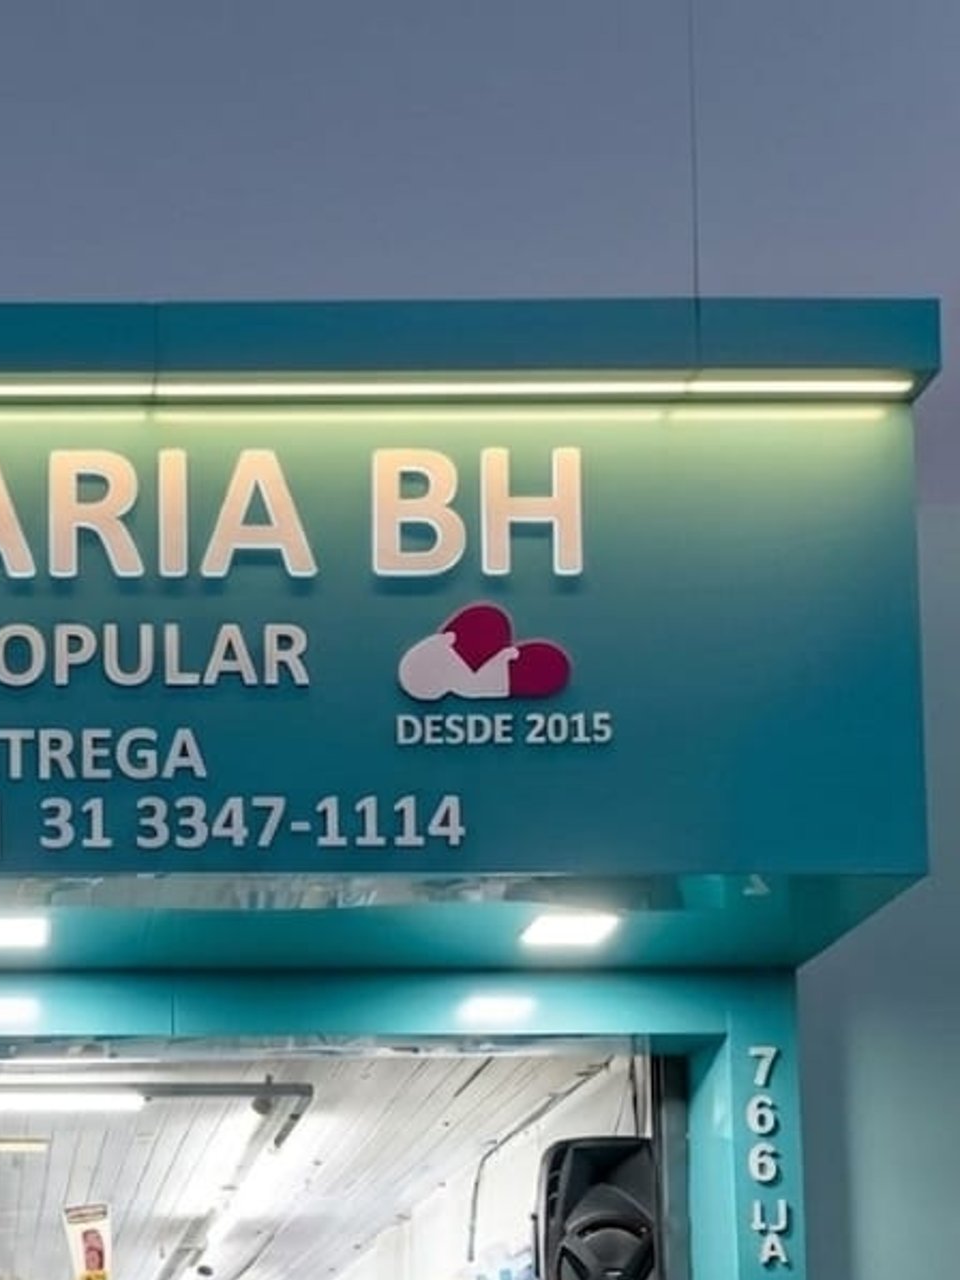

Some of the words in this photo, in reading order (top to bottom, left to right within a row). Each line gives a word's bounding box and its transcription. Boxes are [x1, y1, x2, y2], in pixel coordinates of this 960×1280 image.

[371, 447, 583, 577] BH
[395, 714, 513, 745] DESDE
[525, 712, 613, 744] 2015
[40, 798, 113, 849] 31
[135, 795, 465, 849] 3347-1114
[746, 1046, 777, 1183] 766
